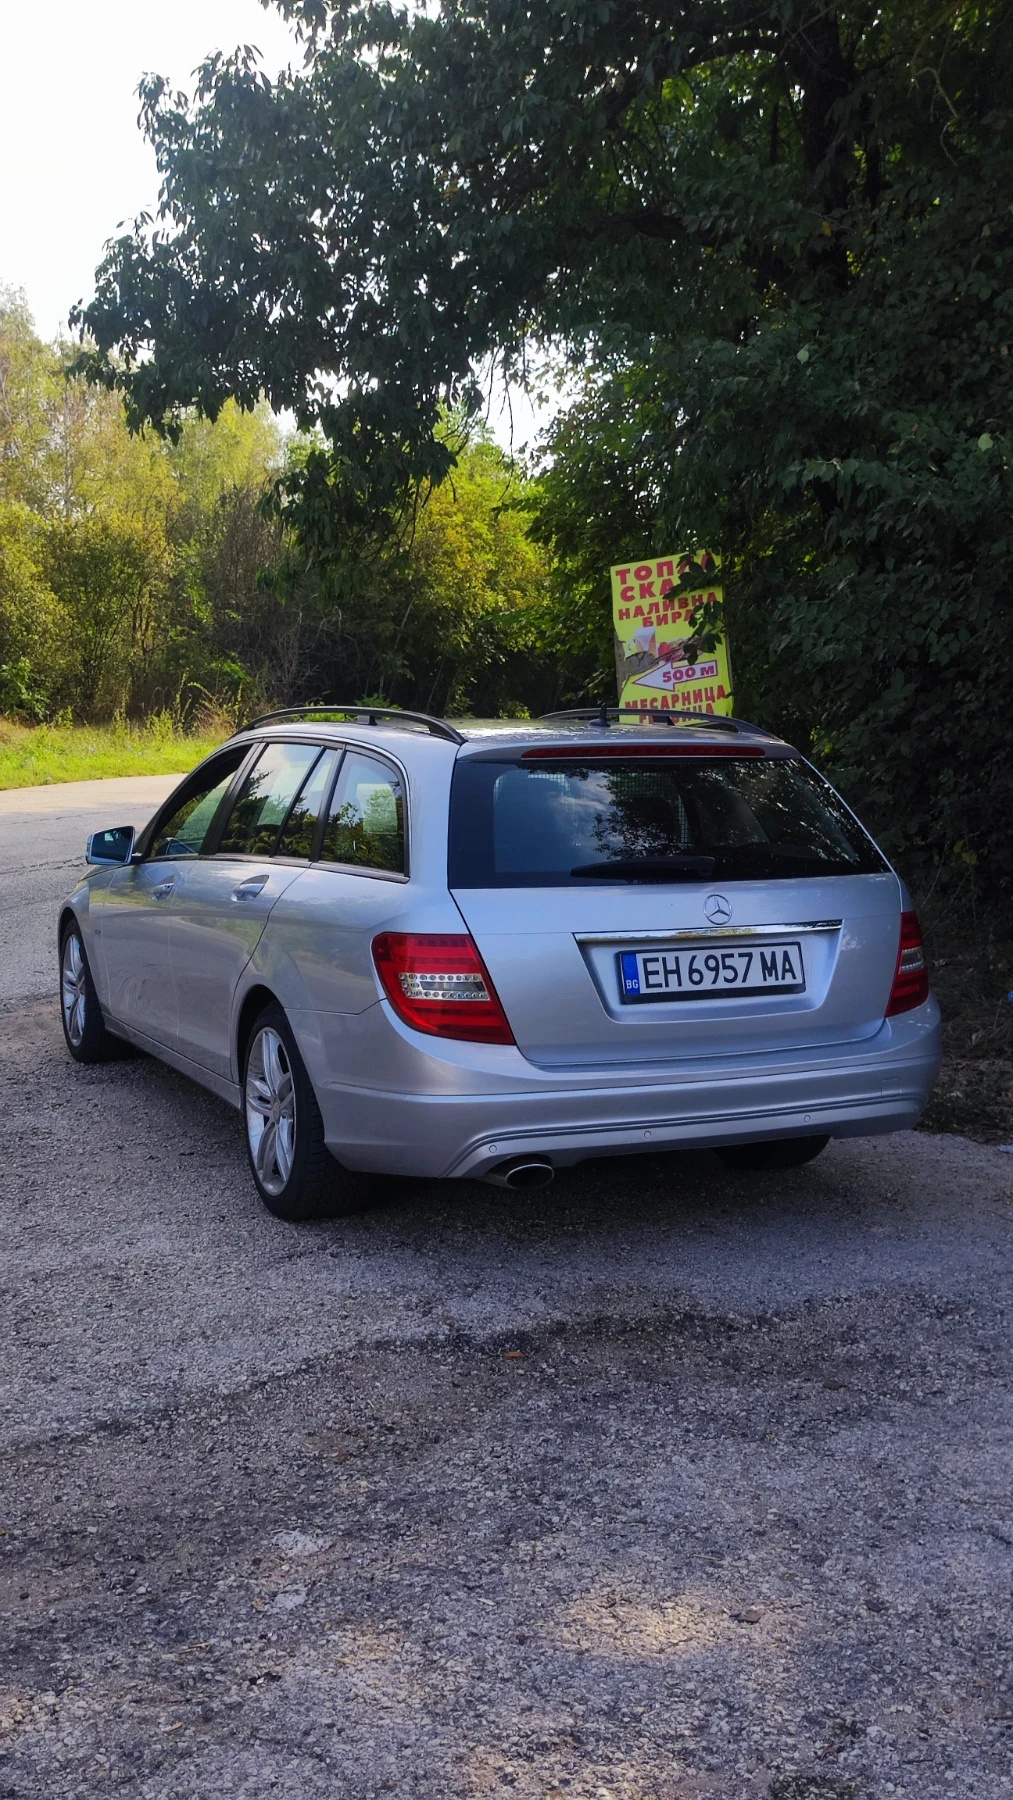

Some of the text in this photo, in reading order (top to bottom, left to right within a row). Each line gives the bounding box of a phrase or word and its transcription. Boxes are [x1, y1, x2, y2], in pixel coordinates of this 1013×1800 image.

[618, 591, 718, 621] НАЛИВНА
[662, 667, 697, 683] 500
[625, 684, 727, 710] МЕСАРНИЦА
[626, 950, 797, 989] BG EH 6957 MA
